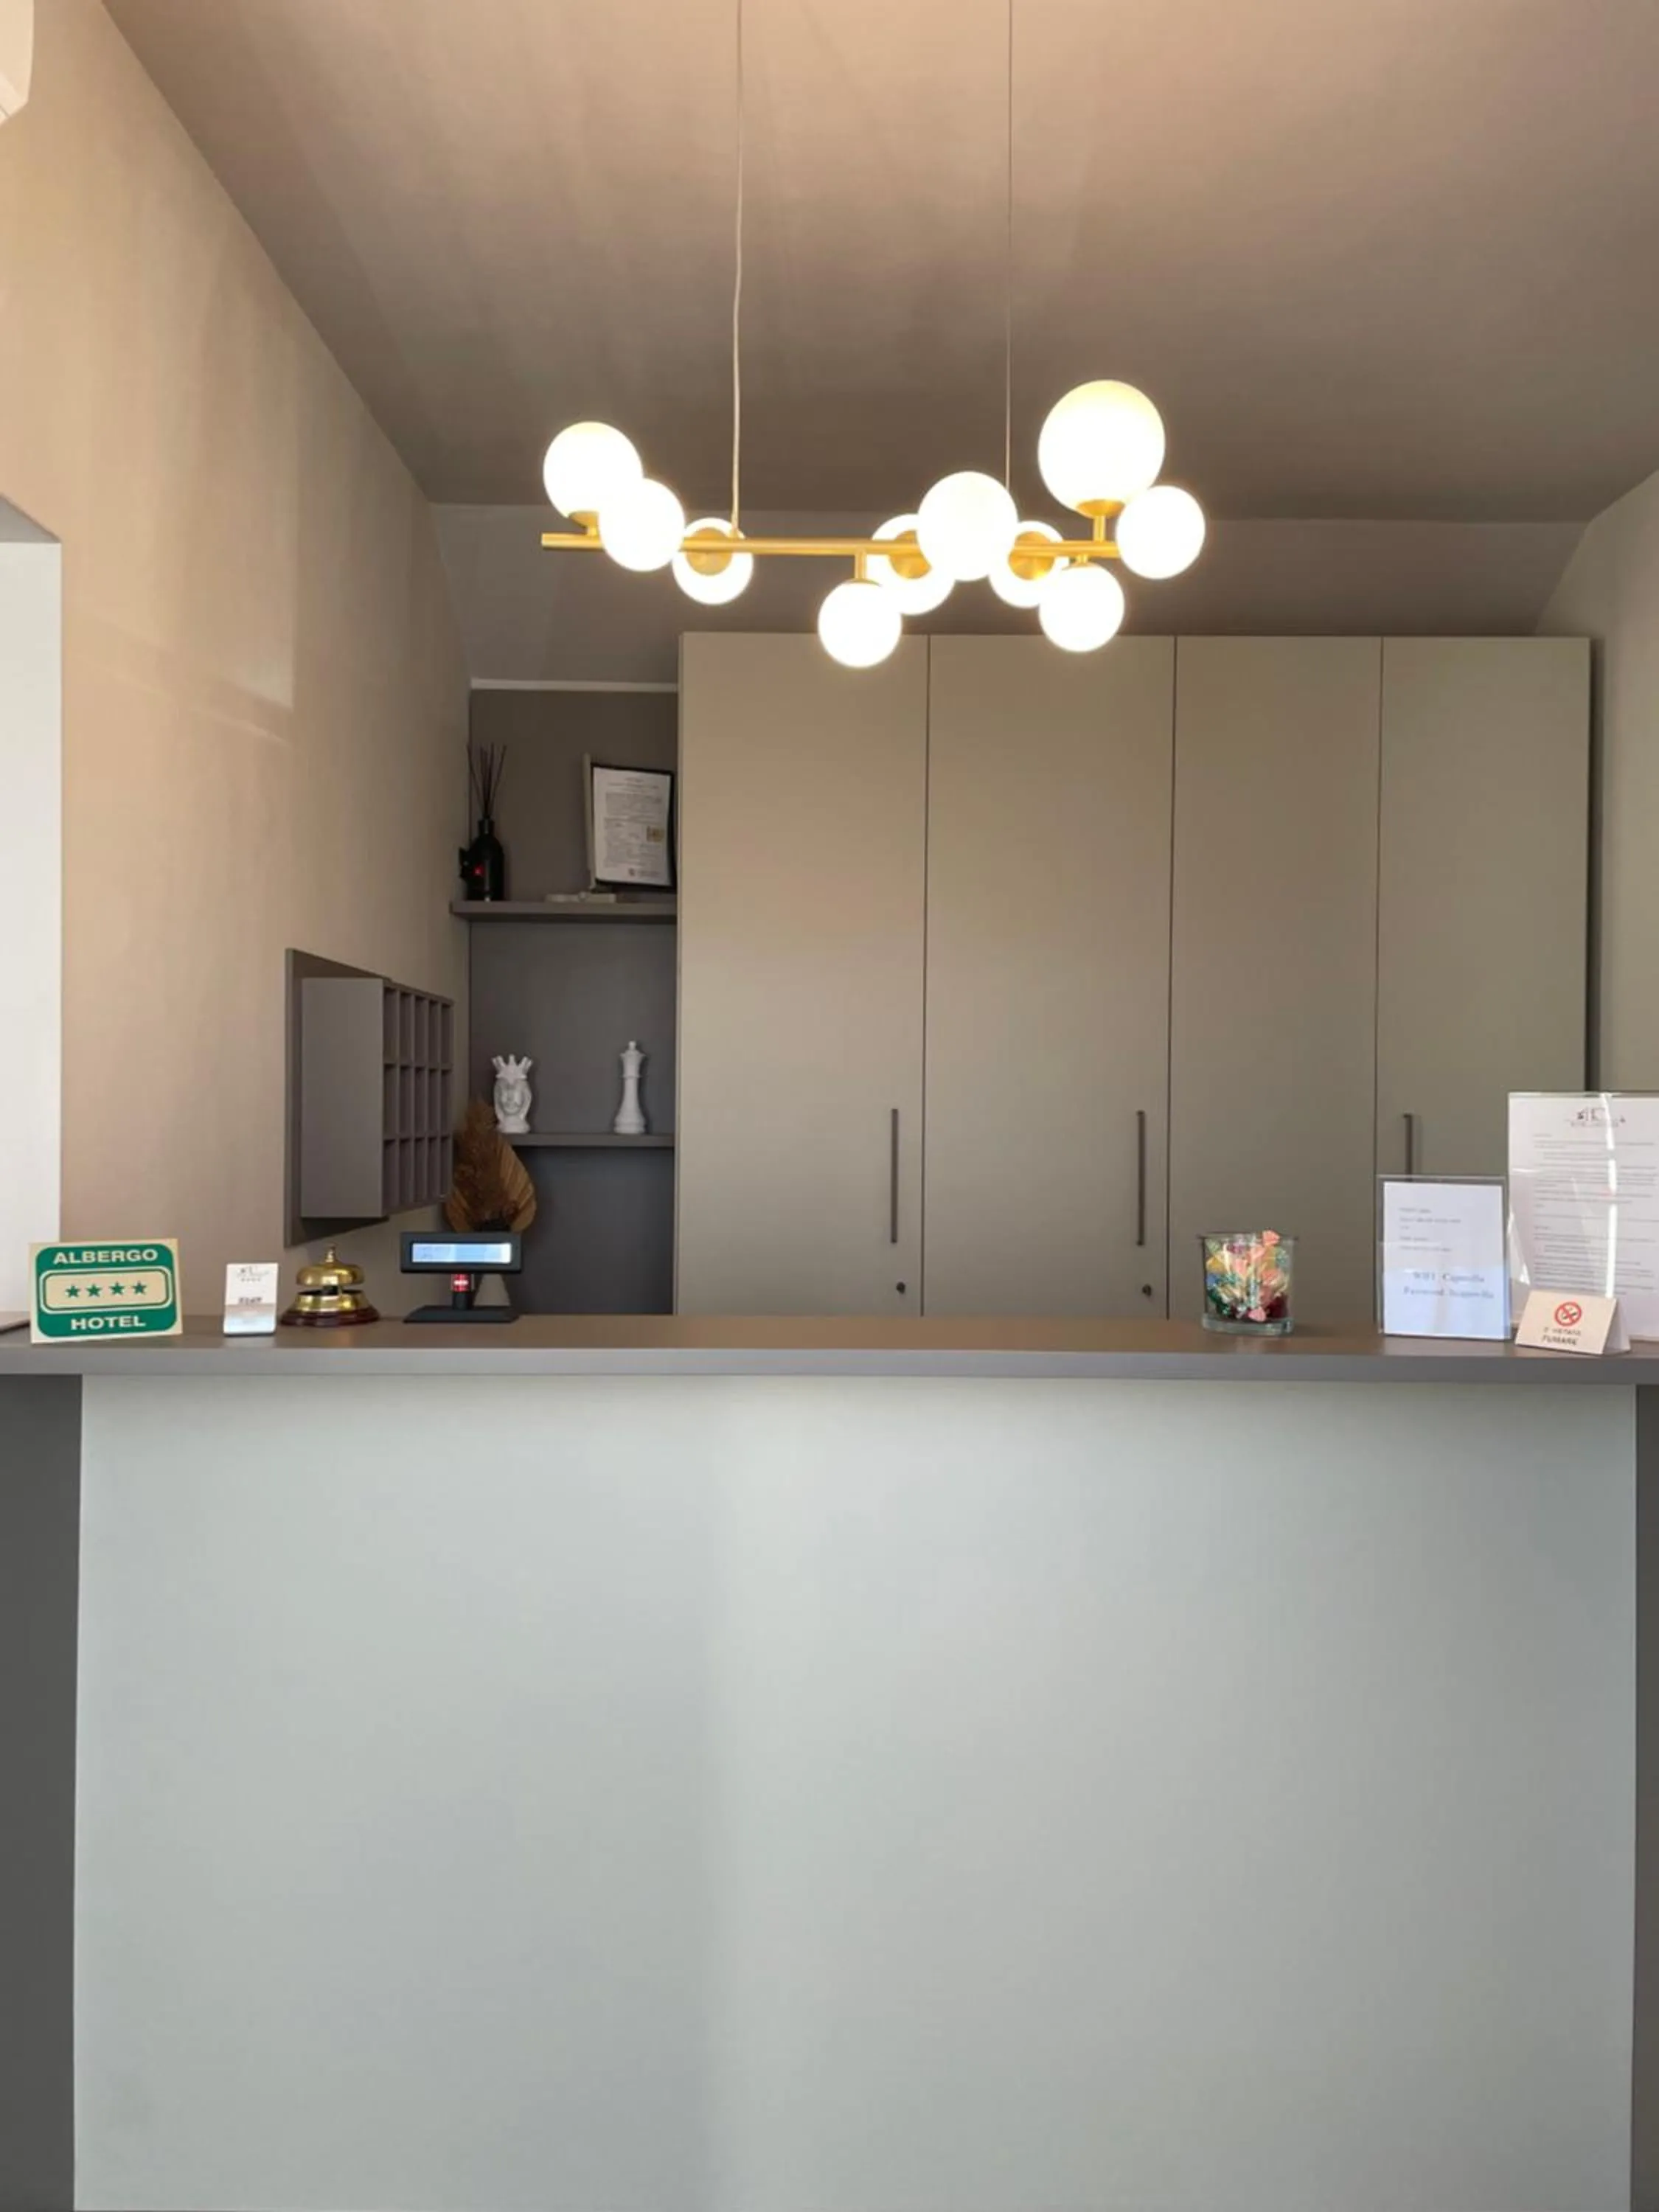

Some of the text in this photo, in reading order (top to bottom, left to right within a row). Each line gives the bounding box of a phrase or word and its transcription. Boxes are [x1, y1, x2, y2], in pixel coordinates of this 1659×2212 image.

[52, 1248, 159, 1265] ALBERGO
[70, 1315, 146, 1331] HOTEL
[1541, 1335, 1578, 1346] FUMARE
